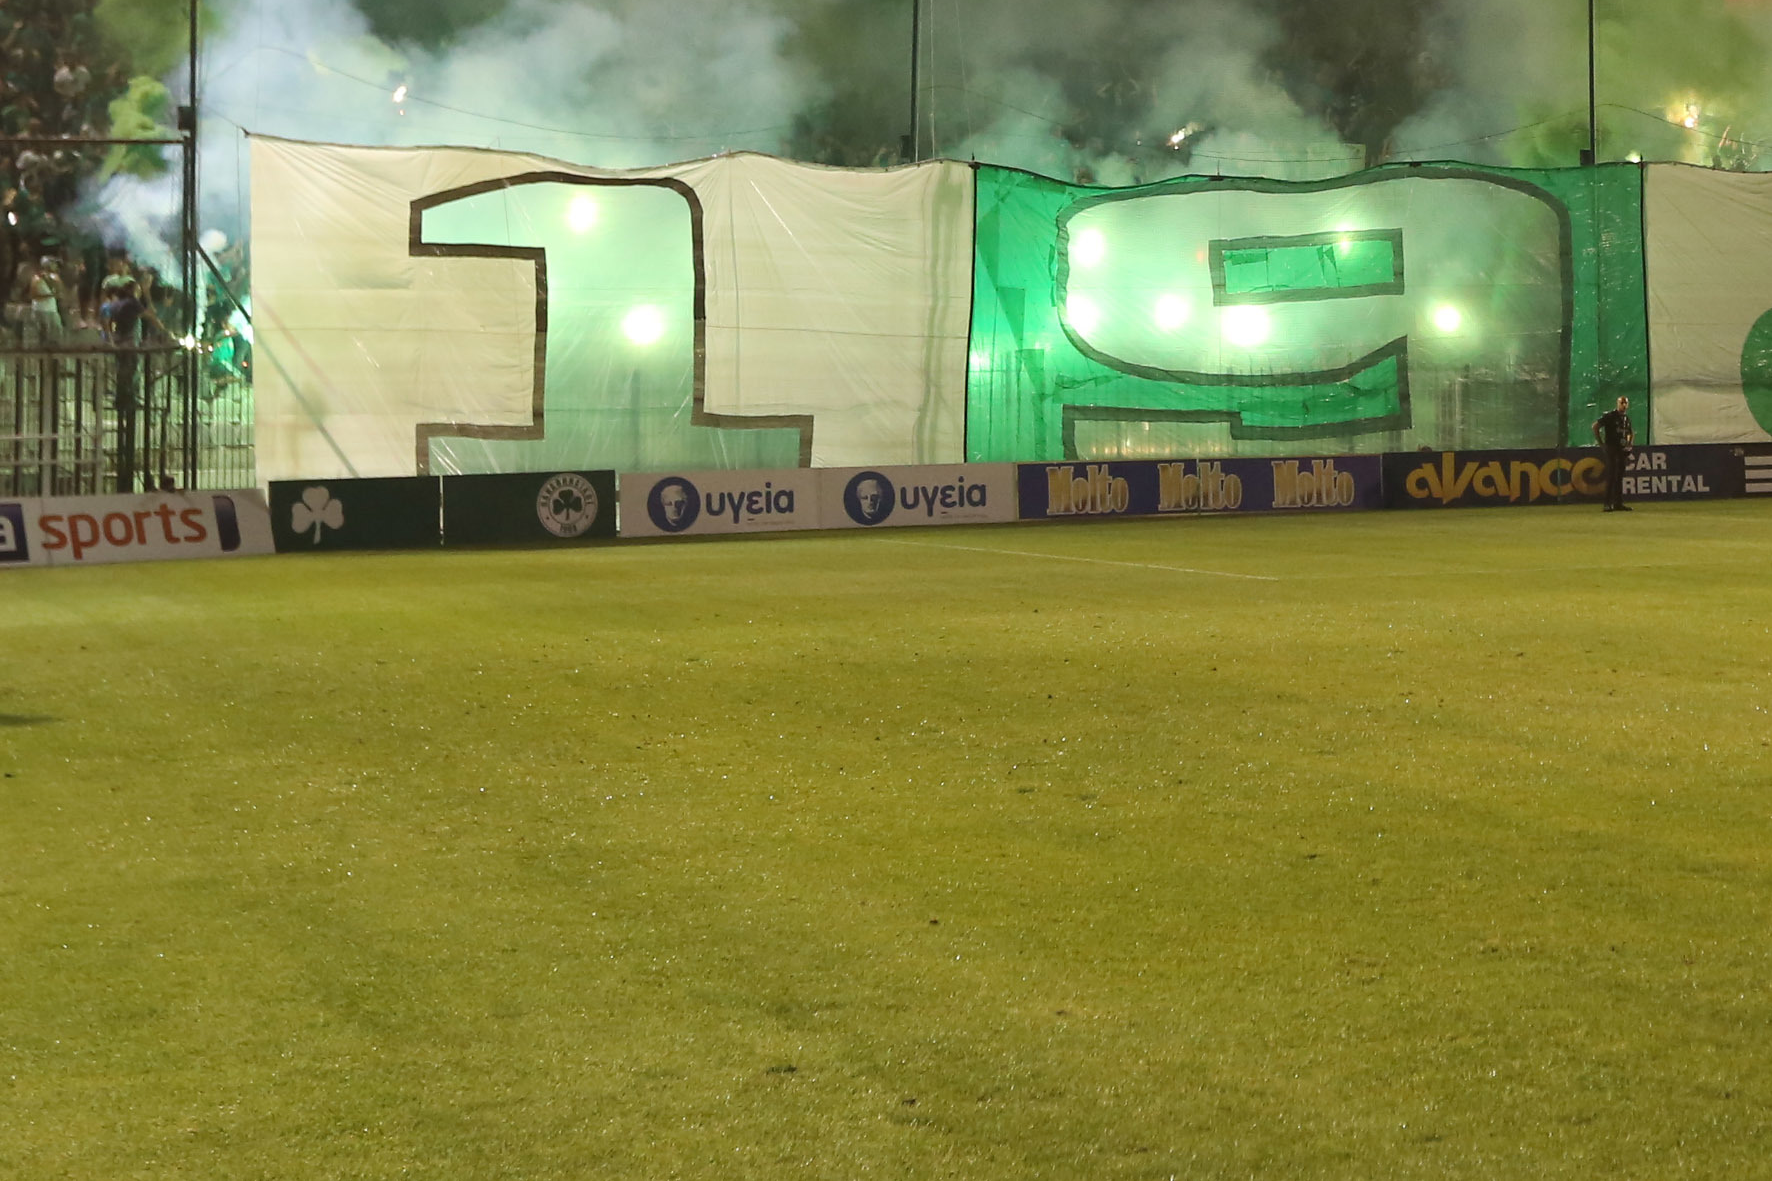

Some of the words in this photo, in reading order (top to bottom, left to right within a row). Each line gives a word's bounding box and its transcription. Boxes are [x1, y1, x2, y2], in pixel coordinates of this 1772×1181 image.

[1046, 464, 1129, 515] Molto
[1158, 461, 1243, 511] Molto
[1271, 459, 1355, 508] Molto
[1622, 475, 1710, 494] RENTAL
[38, 503, 207, 560] sports
